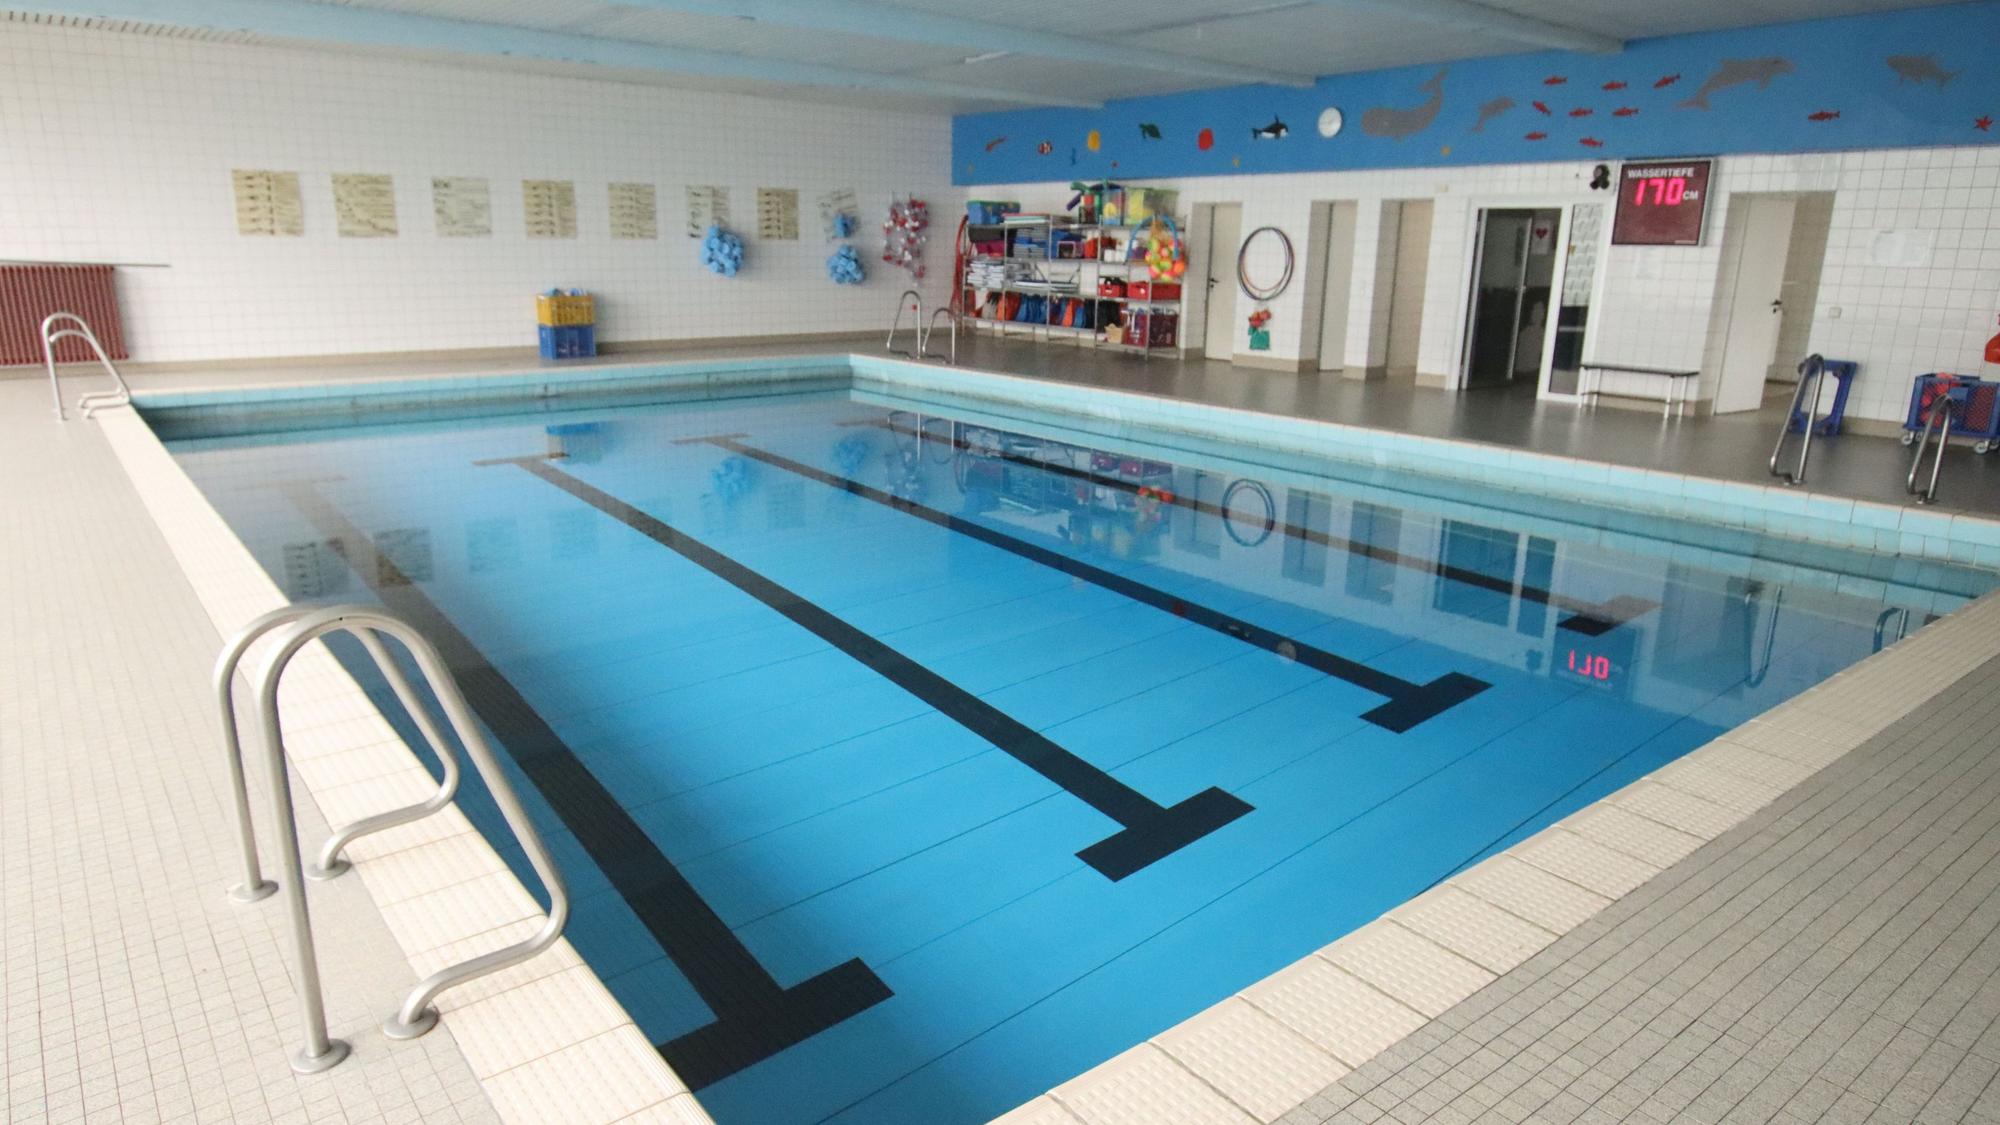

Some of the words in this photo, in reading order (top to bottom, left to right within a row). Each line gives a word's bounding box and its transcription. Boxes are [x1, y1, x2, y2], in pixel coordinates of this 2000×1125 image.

[1628, 167, 1695, 179] WASSERTIEFE
[1635, 178, 1686, 206] 170
[1682, 190, 1699, 200] CM
